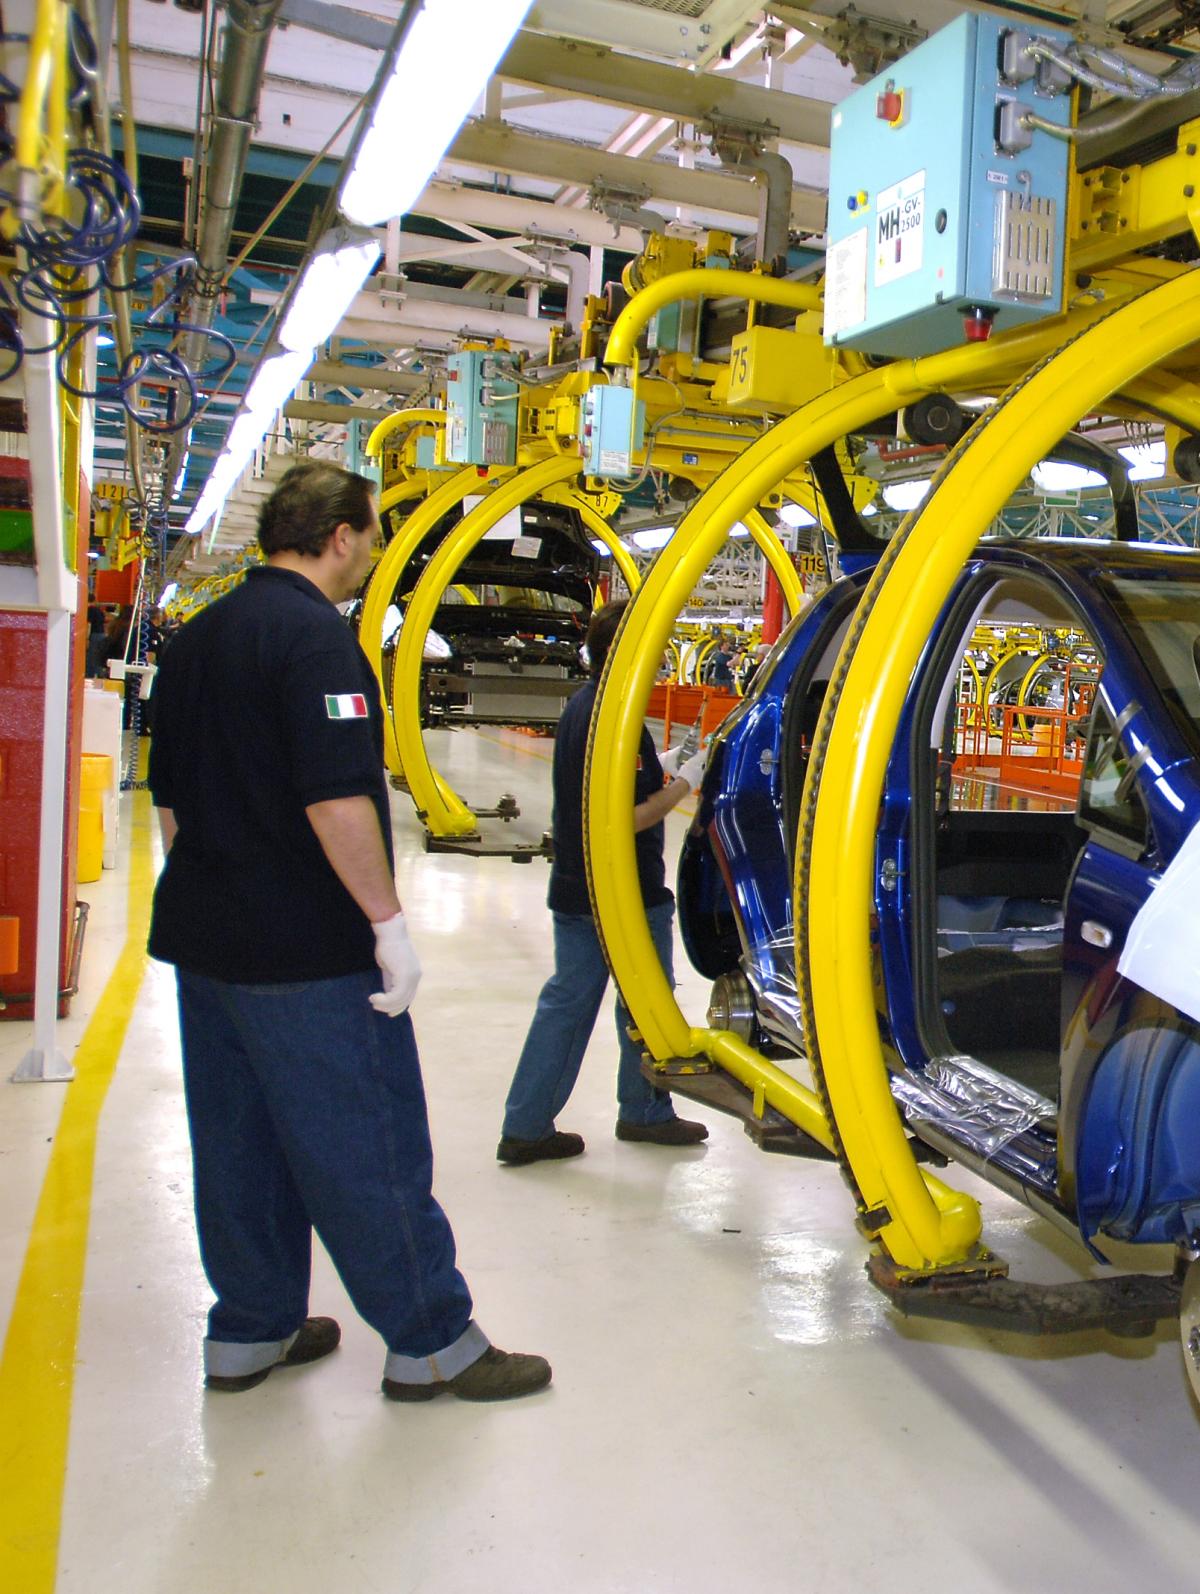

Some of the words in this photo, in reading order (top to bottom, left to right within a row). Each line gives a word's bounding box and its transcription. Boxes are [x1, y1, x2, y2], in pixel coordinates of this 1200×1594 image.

[879, 206, 900, 244] MH
[901, 212, 921, 233] 2500
[731, 344, 748, 386] 75
[102, 484, 125, 498] 121
[802, 556, 825, 573] 119
